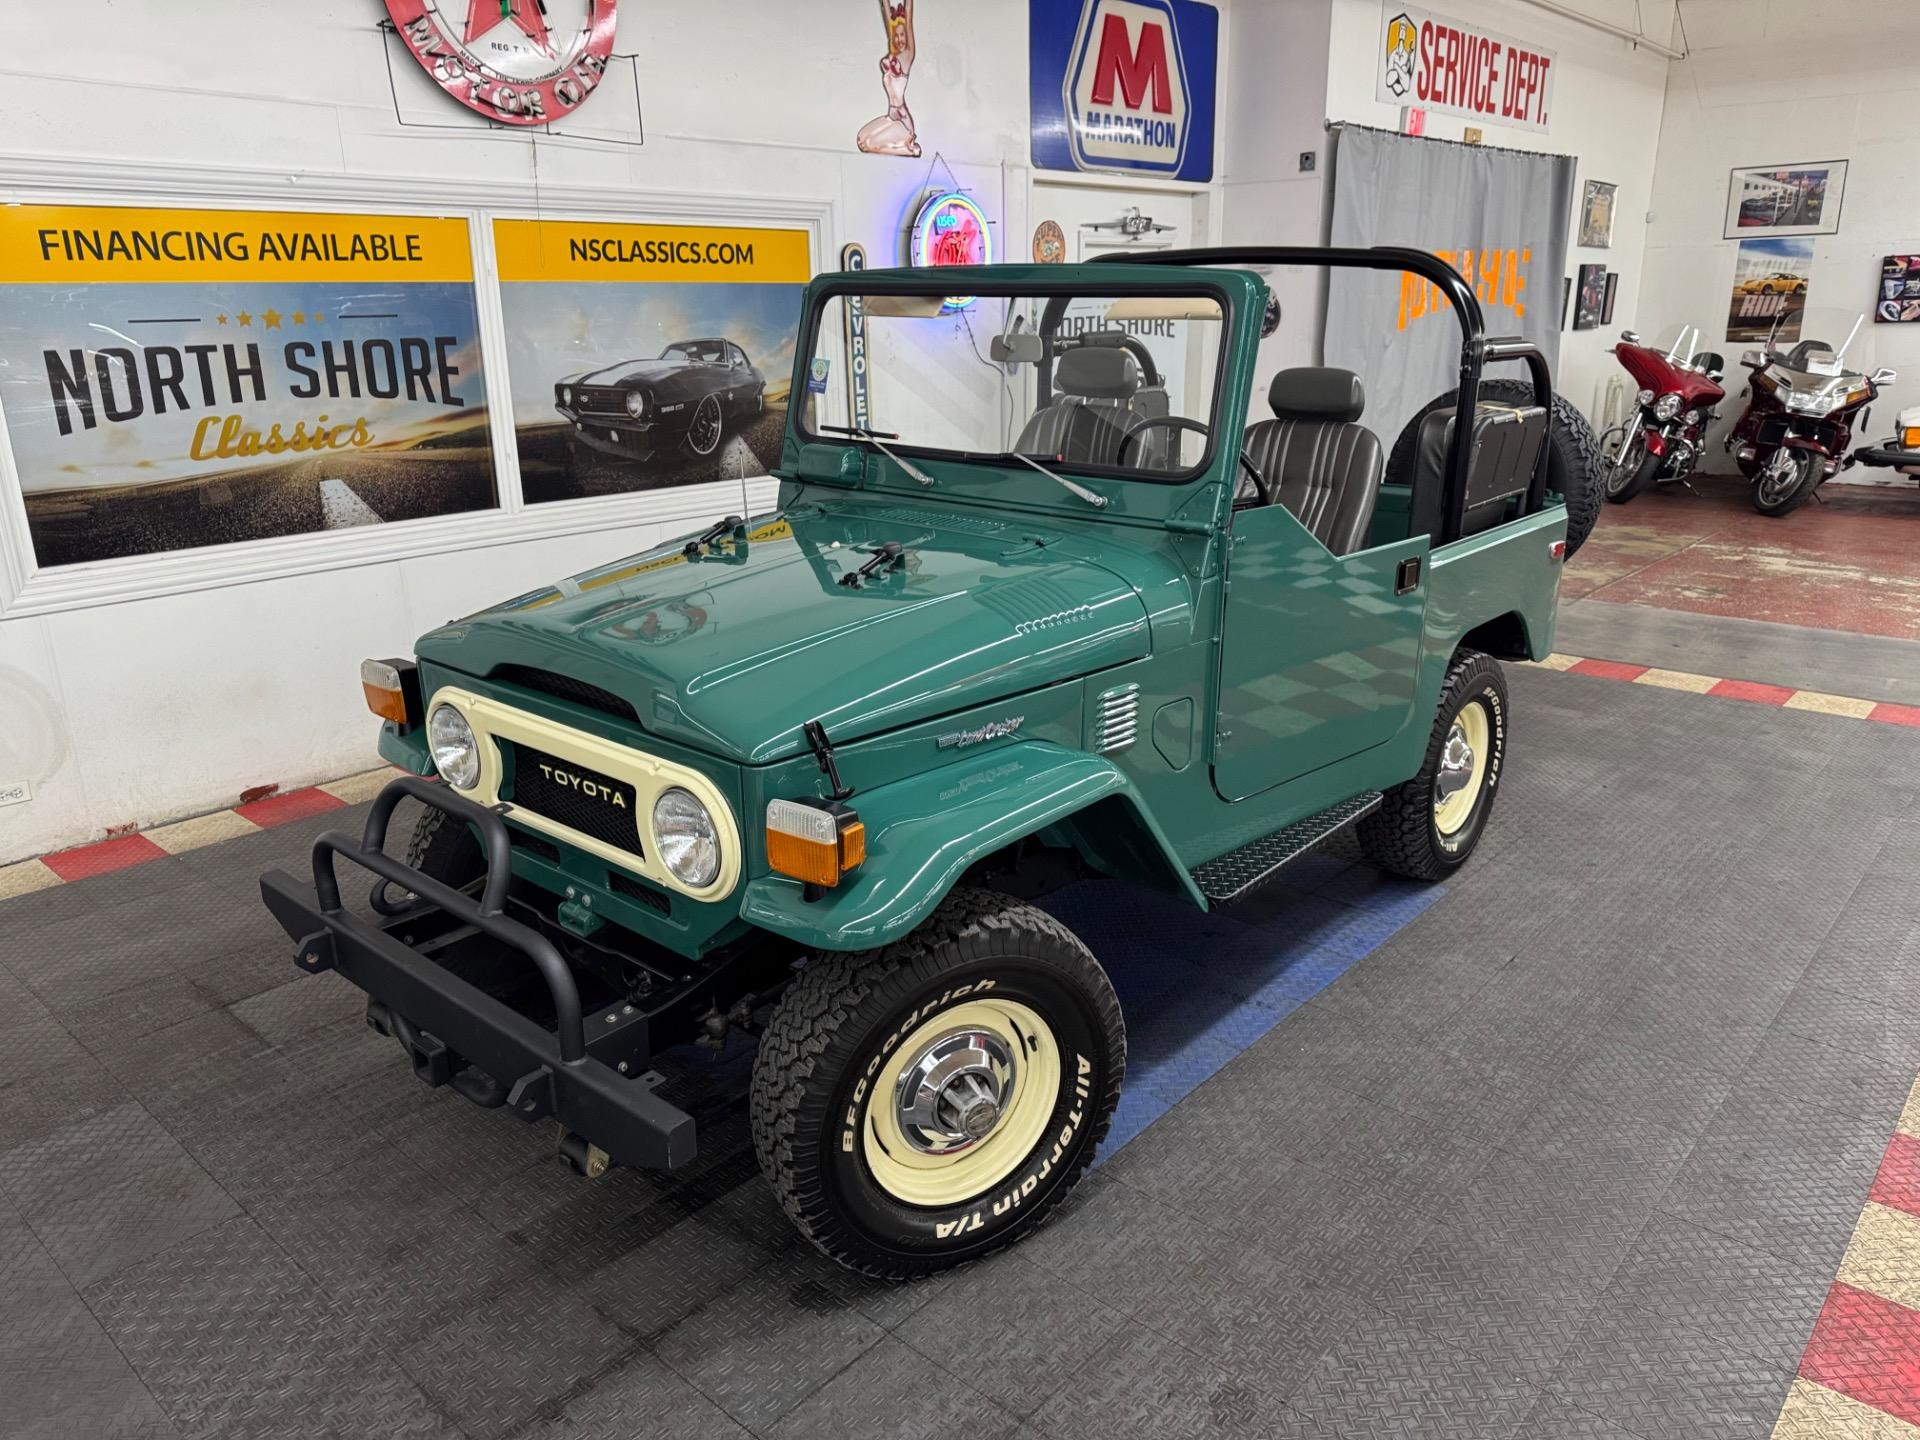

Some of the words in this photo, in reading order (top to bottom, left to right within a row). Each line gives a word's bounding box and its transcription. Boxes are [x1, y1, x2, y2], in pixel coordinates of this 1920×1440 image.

[404, 14, 547, 121] MOTOR
[491, 42, 509, 51] REG
[1416, 20, 1502, 114] SERVICE
[1501, 46, 1550, 125] DEPT.
[1085, 111, 1176, 148] MARATHON
[37, 228, 249, 261] FINANCING
[258, 232, 423, 262] AVAILABLE
[569, 238, 754, 265] NSCLASSICS.COM
[850, 254, 870, 431] CEVROLET
[43, 341, 267, 436] NORTH
[284, 336, 465, 407] SHORE
[189, 414, 375, 462] Classics
[1482, 686, 1504, 787] BFGoodrich
[539, 763, 626, 809] TOYOTA
[842, 978, 996, 1152] BFGoodrich
[992, 1053, 1091, 1216] All-Terrain
[936, 1211, 985, 1239] T/A
